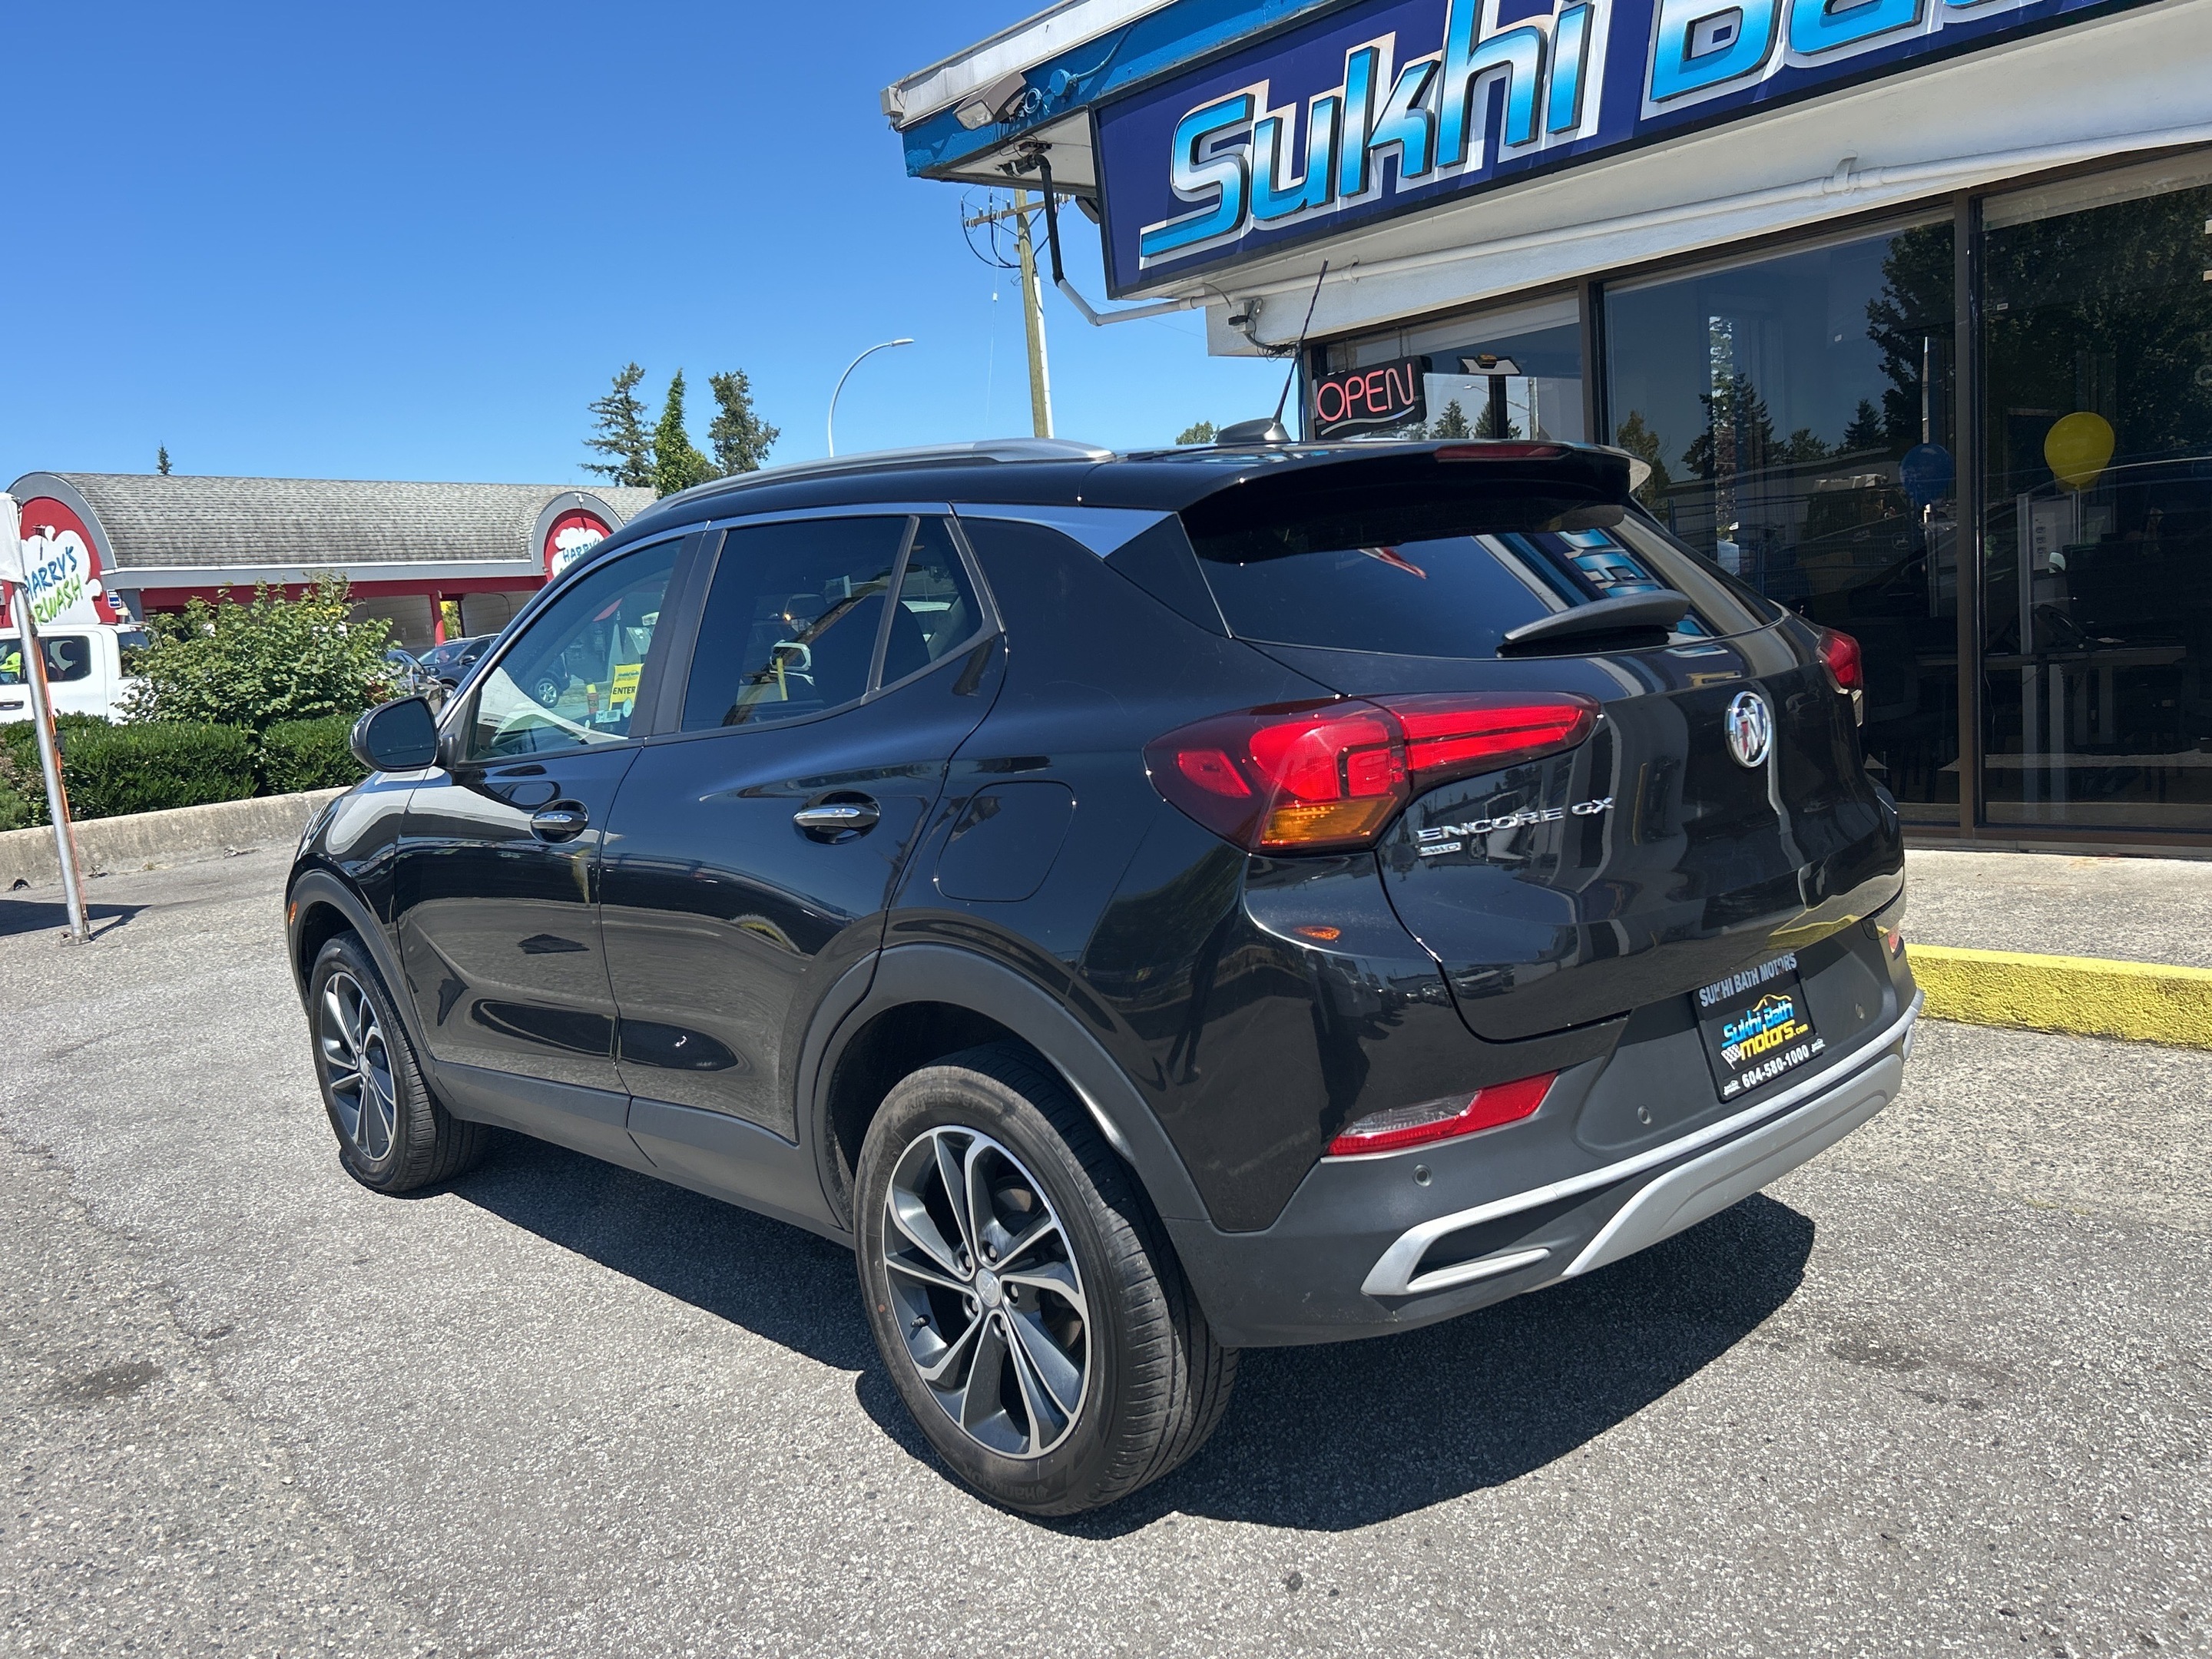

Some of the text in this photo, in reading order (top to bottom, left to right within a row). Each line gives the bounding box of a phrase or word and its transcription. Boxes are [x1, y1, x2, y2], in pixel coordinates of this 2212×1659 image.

[1140, 0, 1594, 260] Sukhi
[1316, 363, 1414, 422] OPEN
[34, 574, 83, 626] RWASH
[612, 686, 636, 695] ENTER
[1416, 807, 1565, 843] ENCORE
[1698, 952, 1798, 1008] SUKHI BATH MOTORS
[1721, 1000, 1795, 1048] Sukhi Bath
[1741, 1045, 1810, 1088] 604-580-1000
